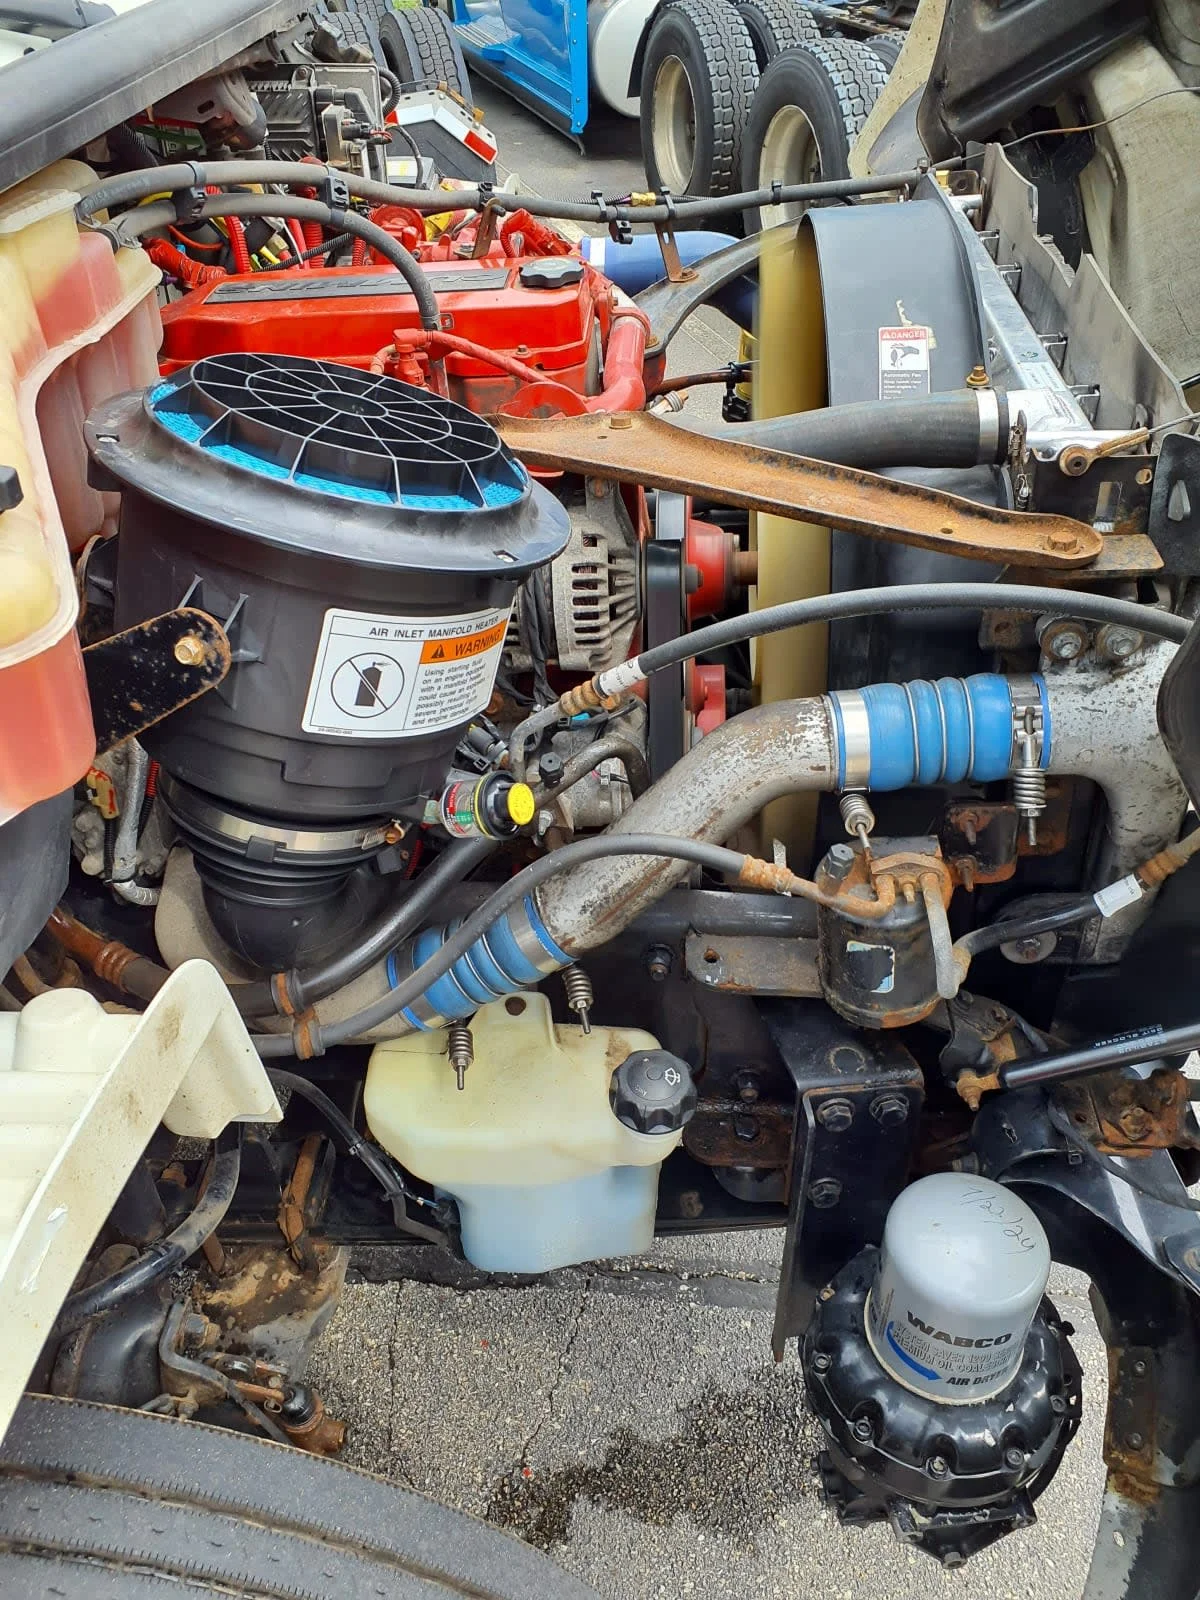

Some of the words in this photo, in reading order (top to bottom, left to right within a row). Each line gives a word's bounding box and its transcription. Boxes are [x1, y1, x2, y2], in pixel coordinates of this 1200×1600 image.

[892, 330, 926, 339] DANGER
[369, 627, 389, 637] AIR
[394, 629, 424, 639] INLET
[428, 624, 472, 638] MANIFOLD
[474, 615, 499, 631] HEATER
[454, 629, 501, 656] WARNING
[424, 669, 445, 677] Using
[447, 663, 470, 673] starting
[445, 673, 465, 682] engine
[421, 685, 435, 693] with
[444, 679, 467, 689] manifold
[416, 701, 444, 710] possibly
[447, 692, 470, 703] resulting
[418, 693, 437, 701] could
[439, 690, 457, 698] cause
[414, 709, 437, 717] severe
[439, 701, 464, 713] personal
[427, 714, 448, 723] engine
[907, 1311, 1012, 1348] WABCO
[938, 1360, 953, 1371] OIL
[946, 1377, 971, 1385] AIR
